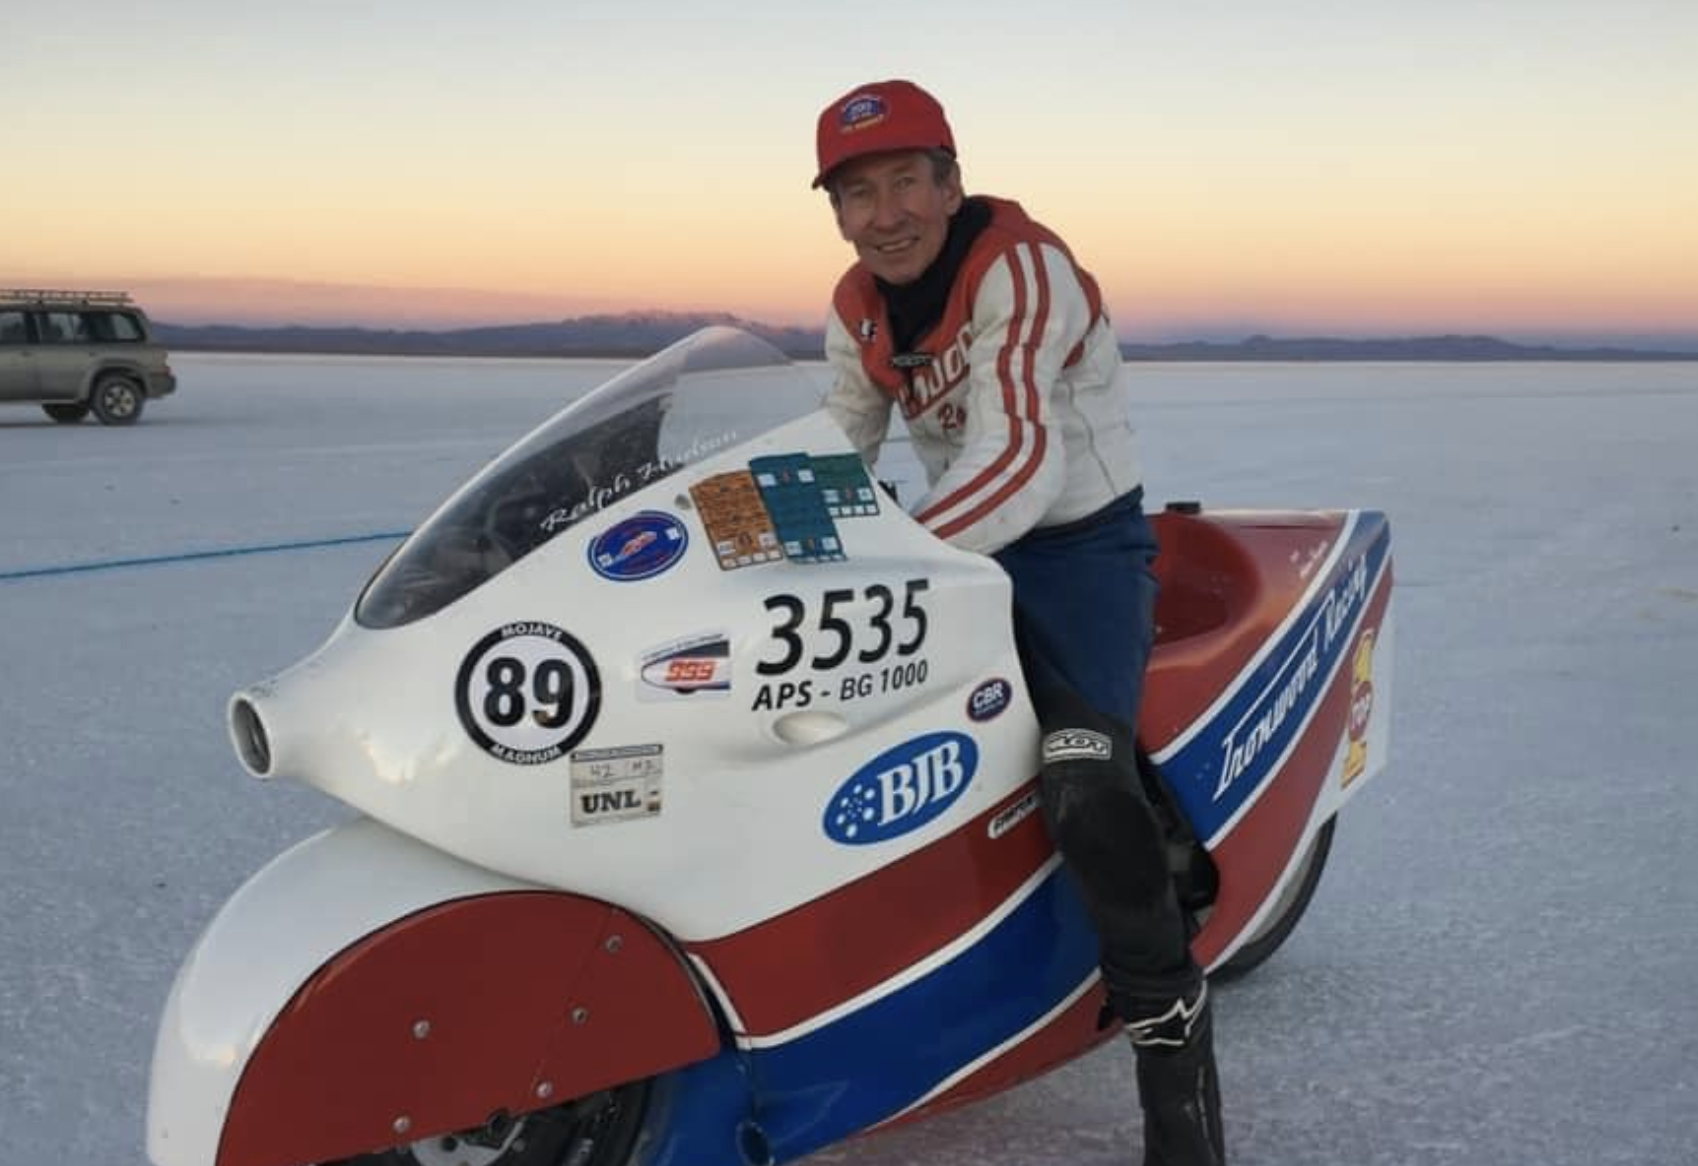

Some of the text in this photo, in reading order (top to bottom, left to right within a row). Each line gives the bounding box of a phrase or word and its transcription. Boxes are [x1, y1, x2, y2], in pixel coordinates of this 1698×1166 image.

[539, 473, 631, 531] Ralph
[501, 622, 563, 641] MOJAVE
[756, 578, 929, 676] 3535
[483, 656, 575, 729] 89
[751, 680, 812, 712] APS
[839, 674, 873, 702] BG
[880, 659, 929, 693] 1000
[492, 744, 563, 765] MAGNUM
[580, 789, 642, 814] UNL
[876, 740, 965, 827] BJB
